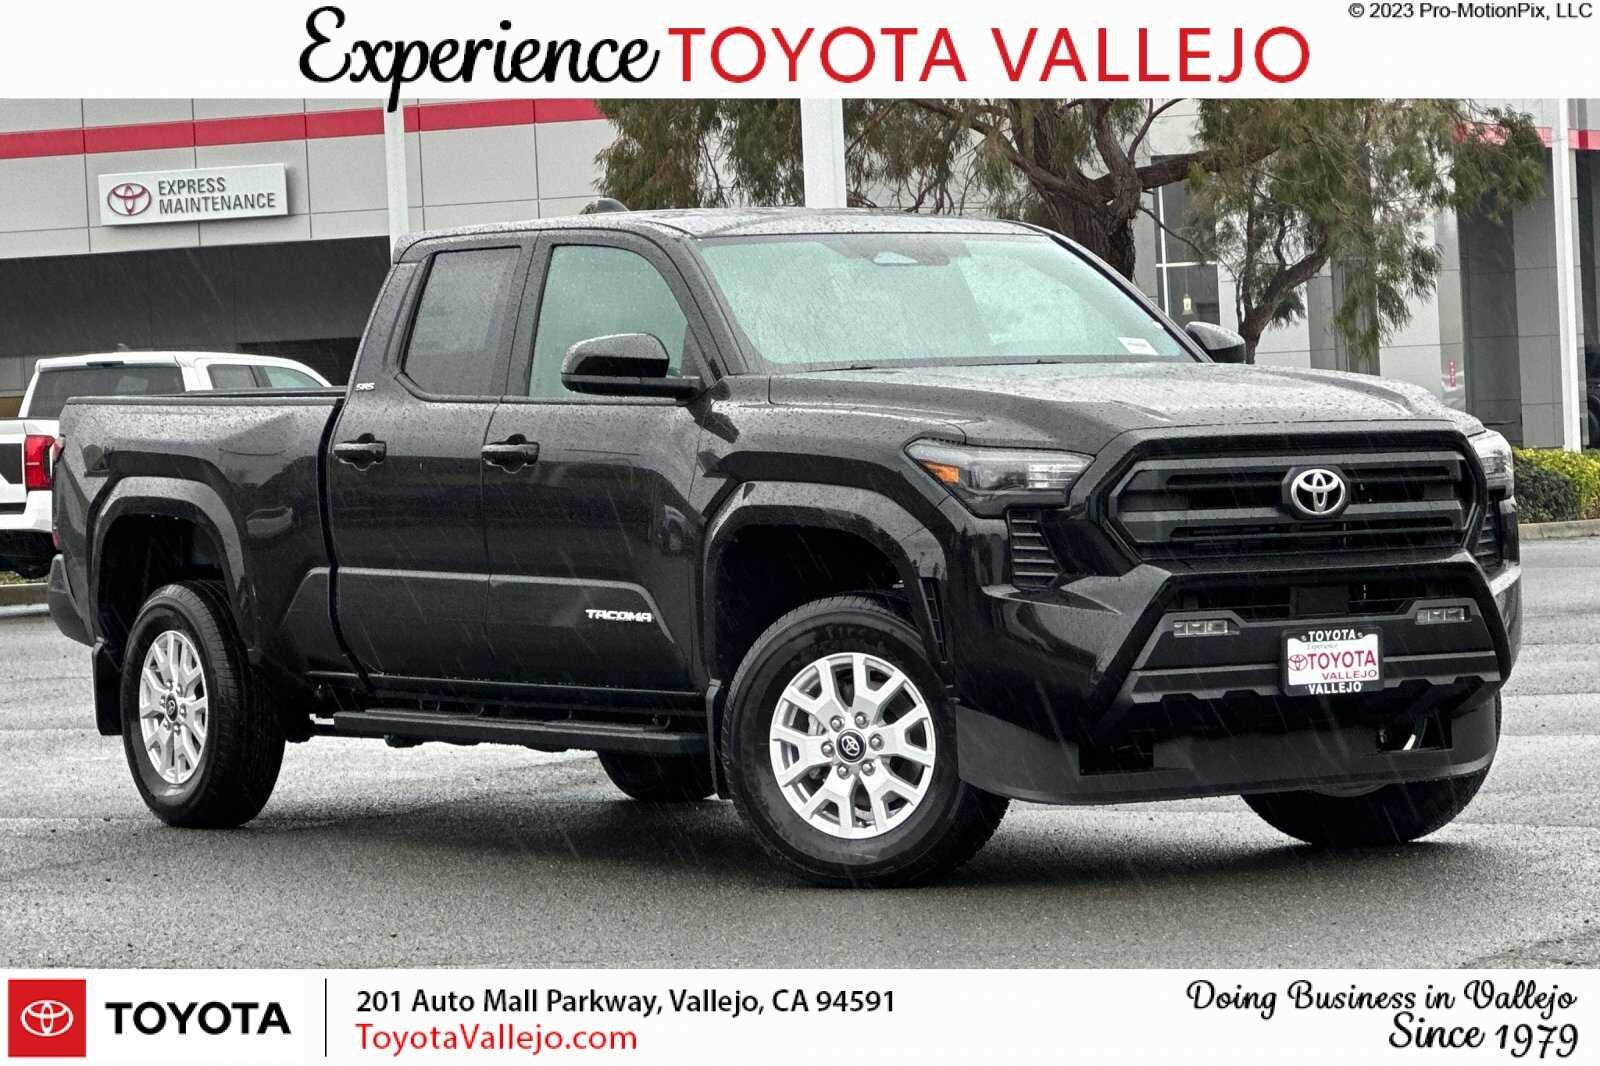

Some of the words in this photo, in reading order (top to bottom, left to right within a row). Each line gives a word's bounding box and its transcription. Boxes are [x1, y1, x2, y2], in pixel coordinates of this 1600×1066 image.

[158, 176, 226, 196] EXPRESS
[159, 192, 276, 215] MAINTENANCE
[585, 609, 652, 623] TACOMA
[1308, 629, 1356, 642] TOYOTA
[1307, 650, 1377, 670] TOYOTA
[1321, 669, 1378, 681] VALLEJO
[1308, 681, 1362, 695] VALLEJO
